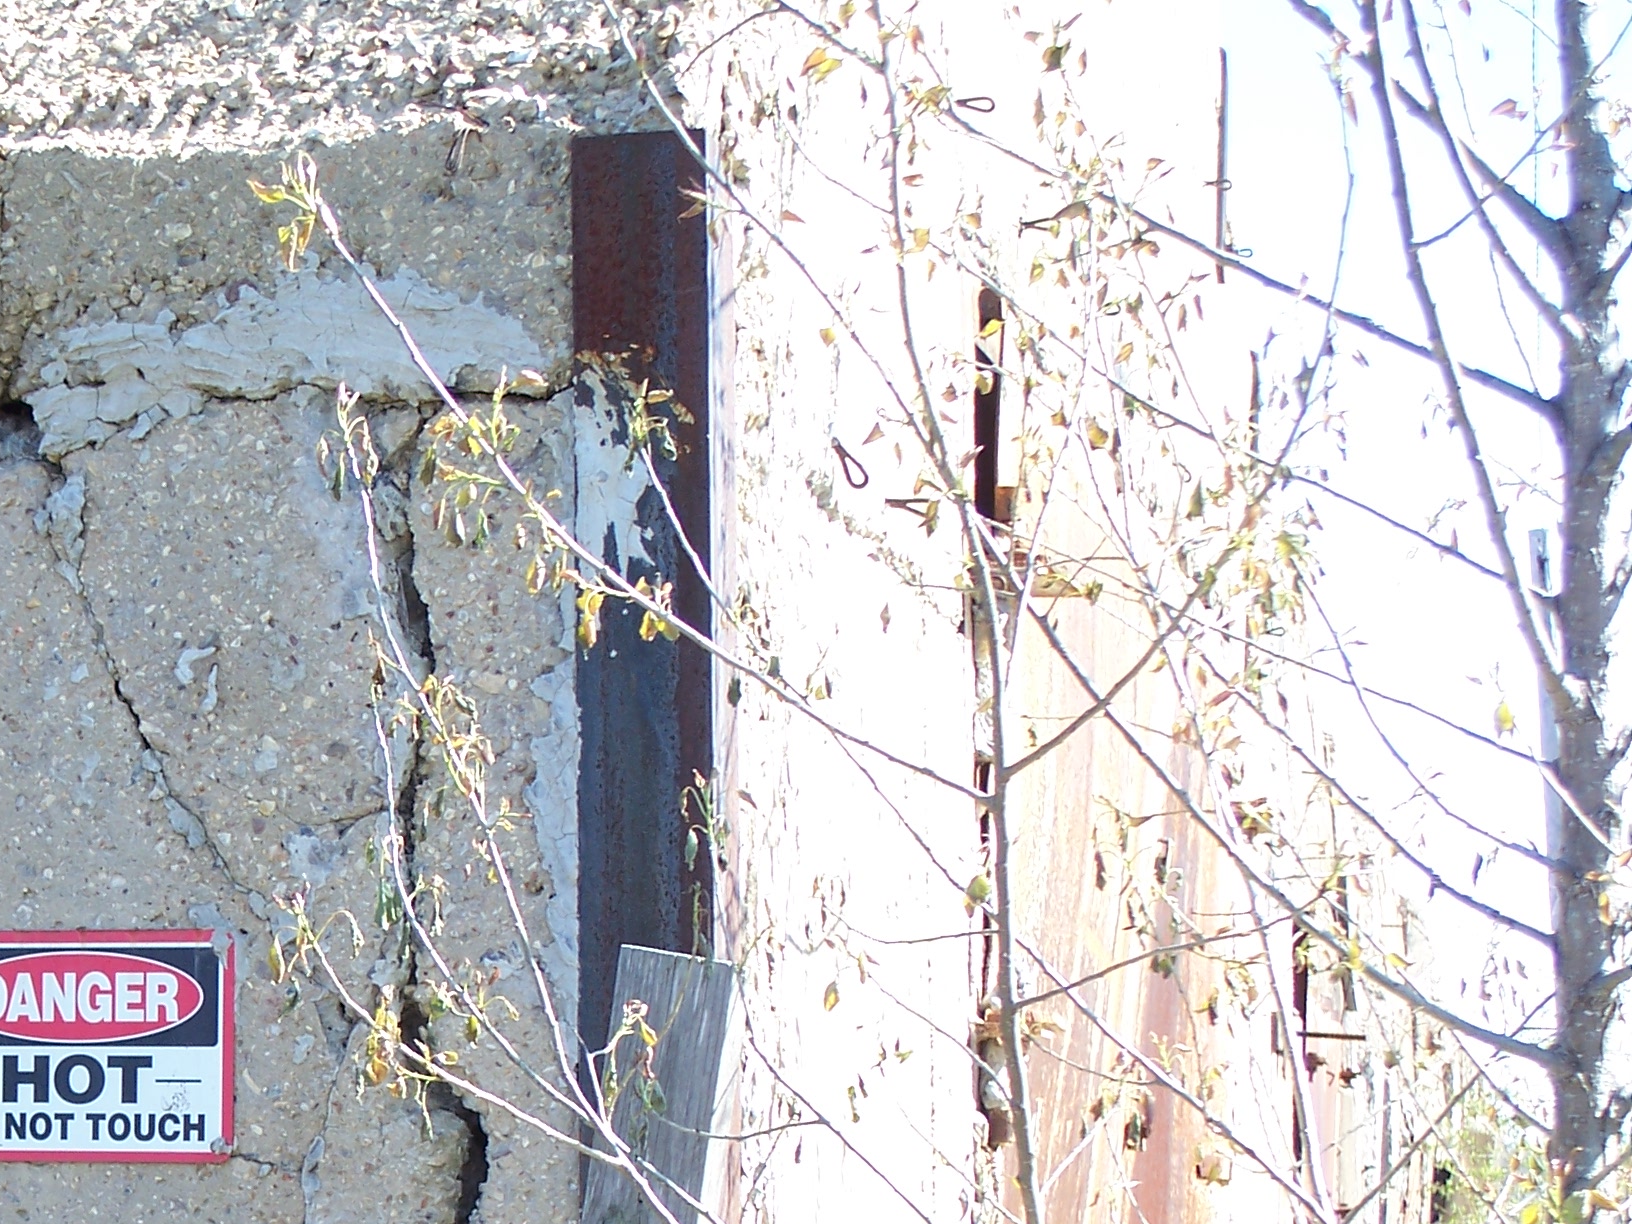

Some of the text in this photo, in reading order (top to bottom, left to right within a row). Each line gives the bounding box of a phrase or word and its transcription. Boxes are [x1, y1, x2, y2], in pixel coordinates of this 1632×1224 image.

[2, 1054, 153, 1104] HOT
[5, 1112, 74, 1140] NOT
[86, 1113, 205, 1142] TOUCH
